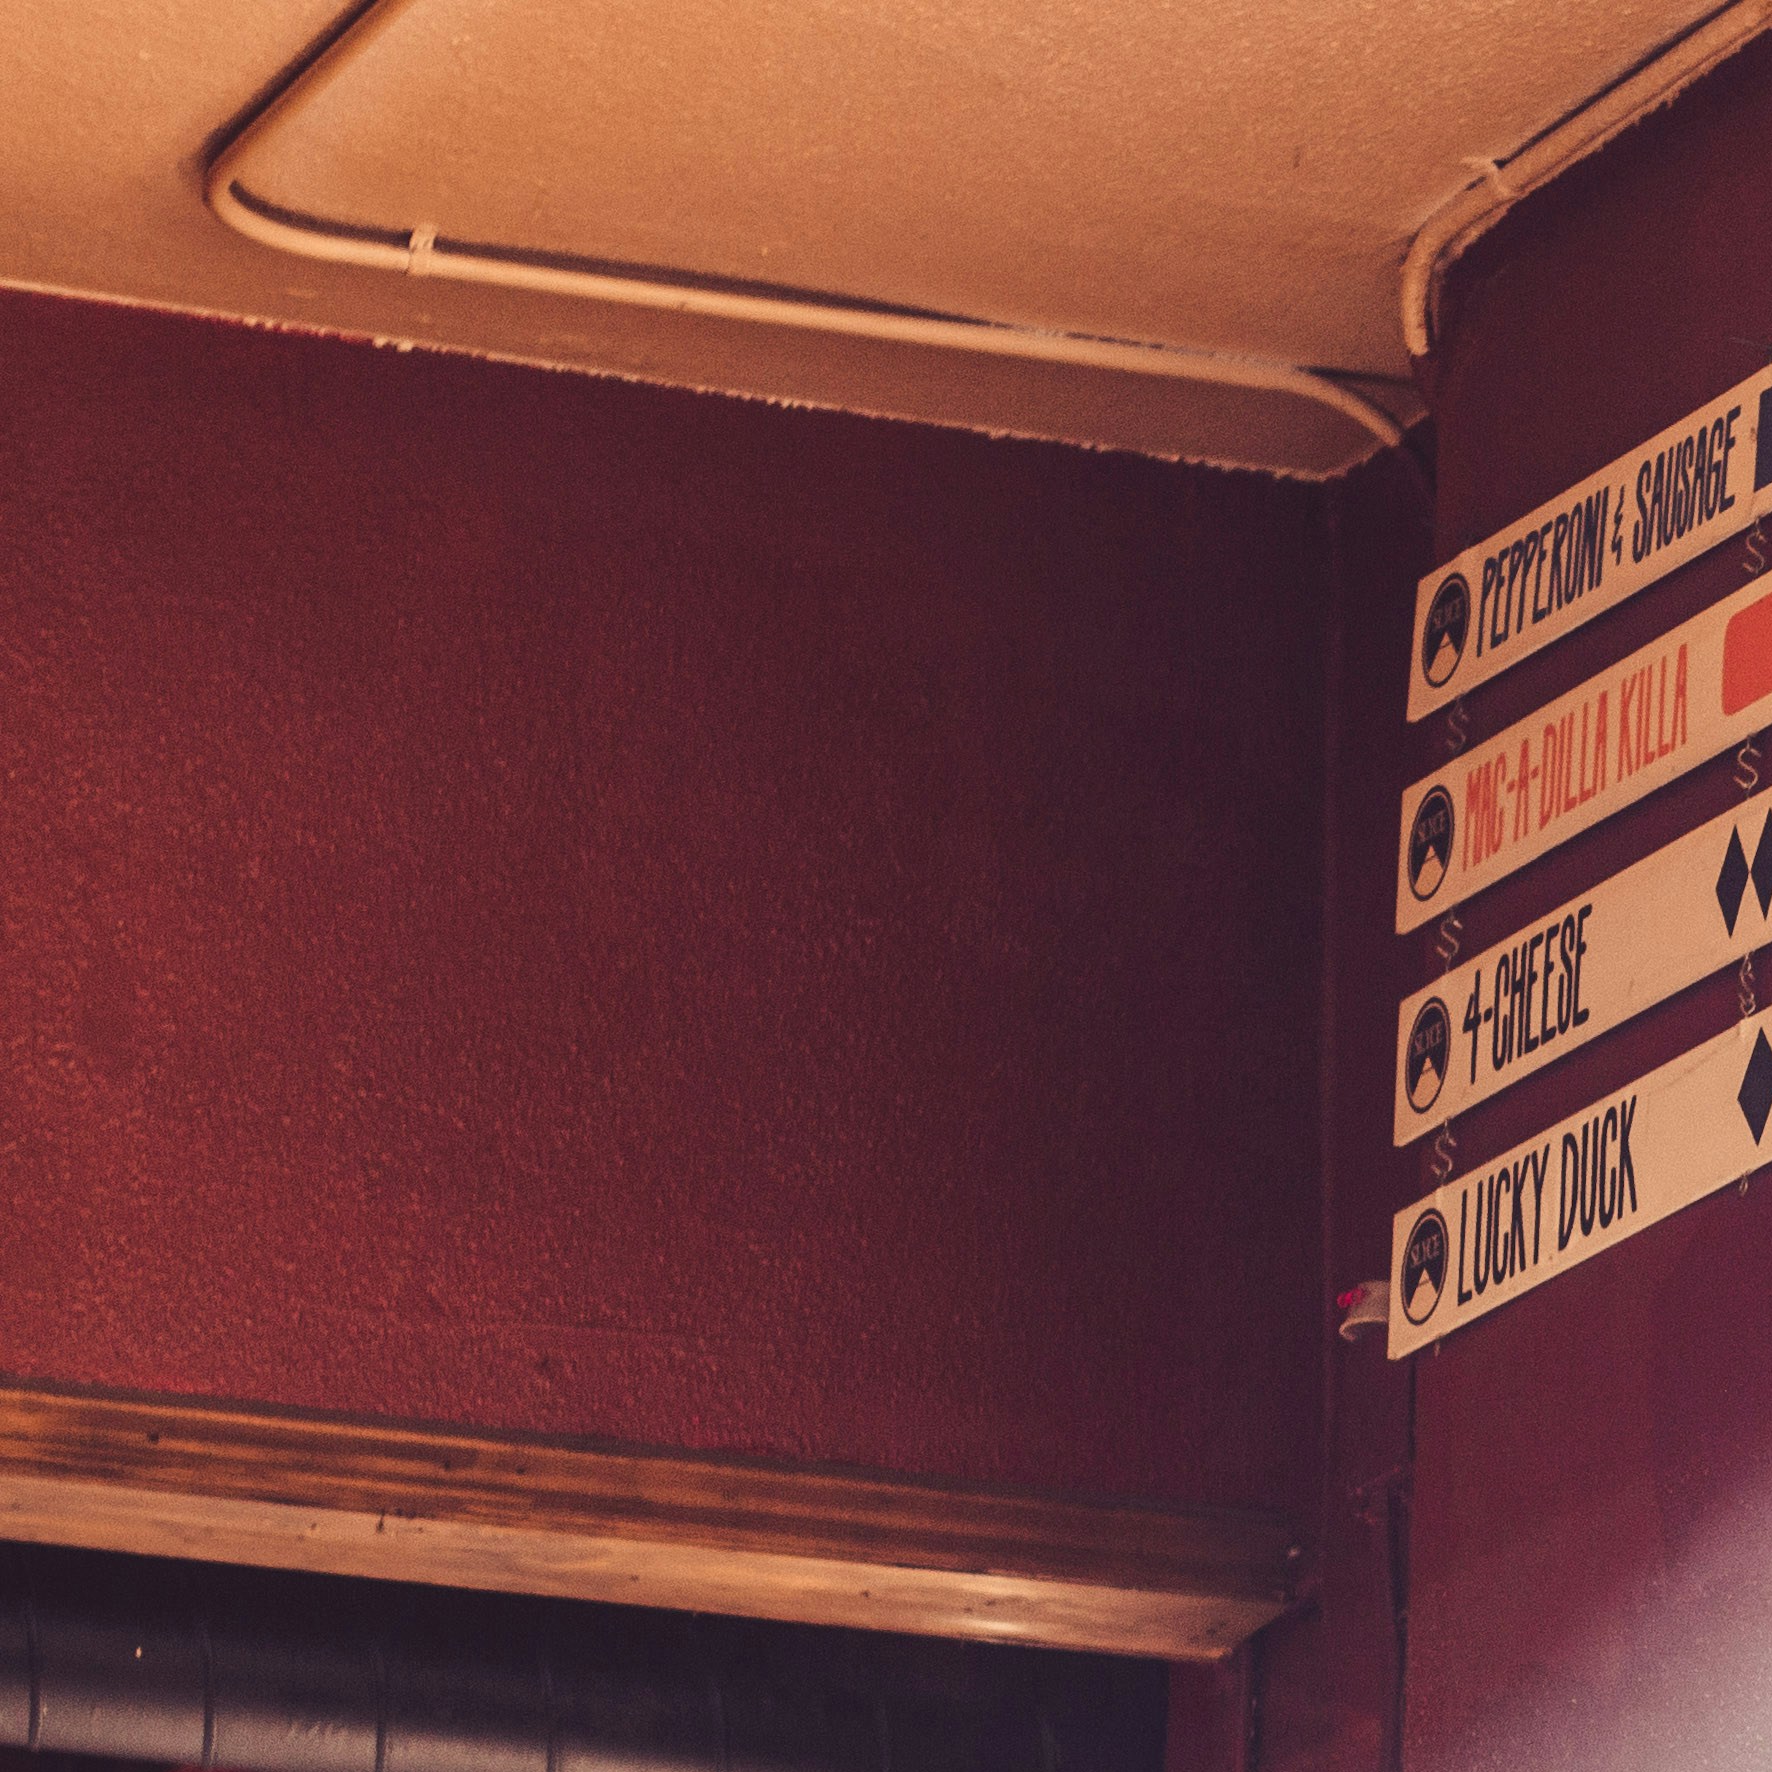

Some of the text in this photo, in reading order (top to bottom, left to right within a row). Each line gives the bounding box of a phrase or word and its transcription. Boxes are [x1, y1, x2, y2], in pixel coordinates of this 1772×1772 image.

[1476, 484, 1609, 659] PEPPERONI
[1632, 404, 1741, 565] SAUSAGE
[1617, 643, 1688, 783] KILLA
[1462, 903, 1593, 1085] 4-CHEESE
[1457, 1094, 1638, 1308] LUCKY DUCK
